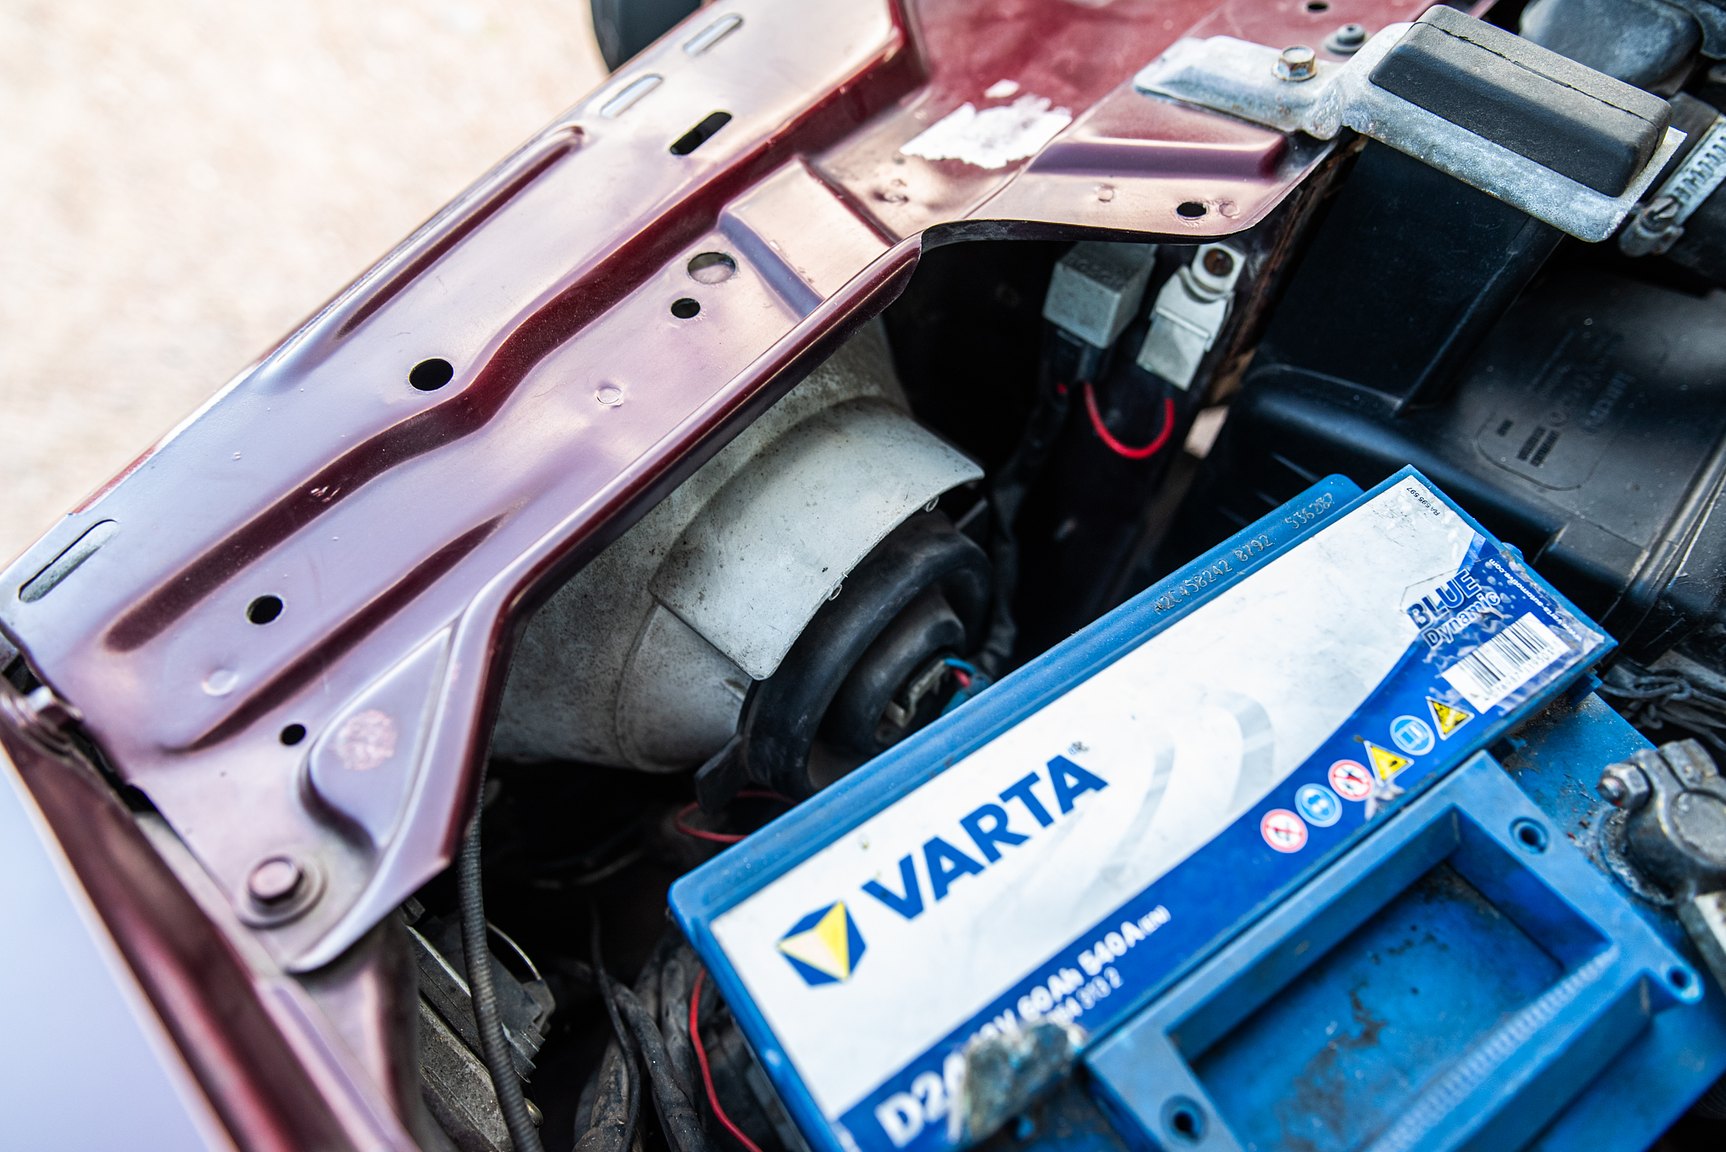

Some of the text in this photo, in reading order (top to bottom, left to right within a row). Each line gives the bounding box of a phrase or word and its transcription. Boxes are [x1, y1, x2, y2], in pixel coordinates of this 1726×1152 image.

[1407, 568, 1482, 630] BLUE
[1423, 591, 1500, 650] Dynamic
[861, 754, 1109, 921] VARTA
[1017, 967, 1084, 1022] 60Ah
